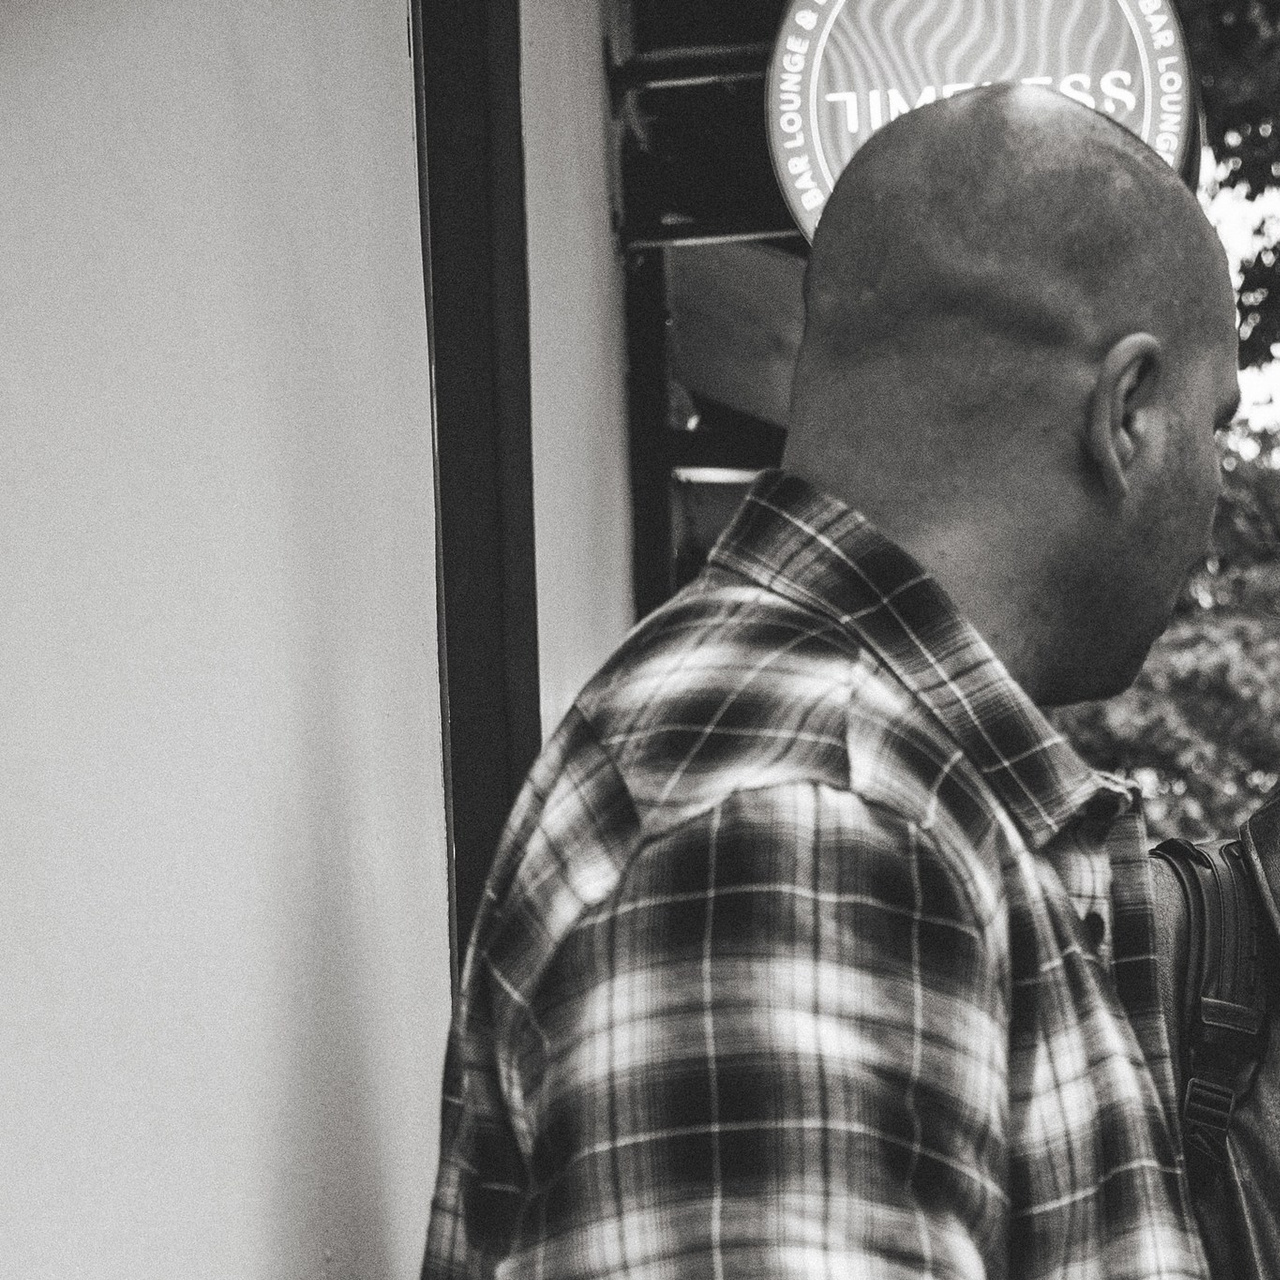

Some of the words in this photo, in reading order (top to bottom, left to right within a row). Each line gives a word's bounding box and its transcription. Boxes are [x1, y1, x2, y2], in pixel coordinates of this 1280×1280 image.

[1138, 0, 1175, 50] BAR
[779, 35, 810, 149] LOUNGE
[825, 69, 1137, 134] TIMSS
[787, 154, 825, 211] BAR
